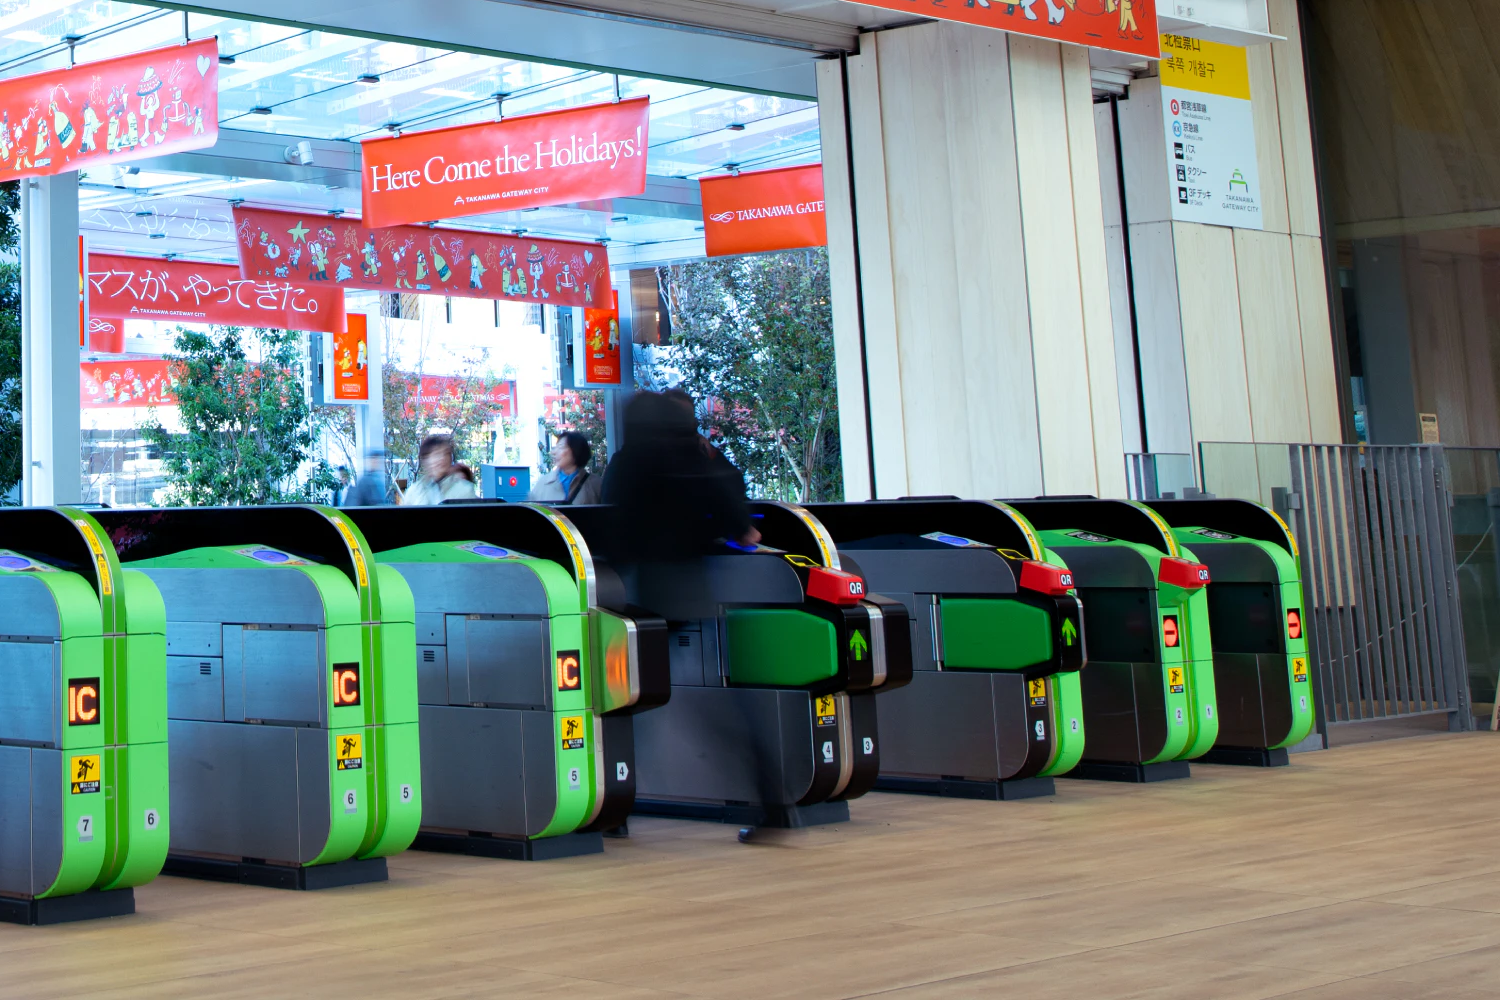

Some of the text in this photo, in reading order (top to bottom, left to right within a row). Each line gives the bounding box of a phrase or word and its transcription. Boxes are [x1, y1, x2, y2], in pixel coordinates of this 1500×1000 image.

[1189, 60, 1216, 79] 개찰구
[1185, 144, 1196, 154] バス
[370, 125, 643, 193] Here Come the Holidays!
[1187, 166, 1207, 176] タクシー
[466, 186, 549, 203] TAKANAWA GATEWAY CITY
[1225, 195, 1254, 203] TAKANAWA
[736, 200, 825, 221] TAKANAWA GATE
[1222, 202, 1246, 211] GATEWAY
[140, 307, 169, 315] TAKANAWA
[169, 309, 193, 317] GATEWAY
[1060, 574, 1072, 585] QR
[1198, 570, 1209, 580] QR
[849, 582, 863, 595] QR
[557, 657, 579, 688] IC
[333, 669, 358, 704] IC
[69, 686, 97, 721] IC
[1177, 709, 1182, 718] 2
[1038, 723, 1043, 733] 3
[1072, 720, 1076, 730] 2
[825, 744, 831, 755] 4
[865, 741, 870, 751] 3
[572, 770, 577, 782] 5
[619, 765, 625, 778] 4
[403, 786, 409, 799] 5
[347, 793, 354, 805] 6
[147, 812, 155, 825] 6
[82, 819, 90, 832] 7
